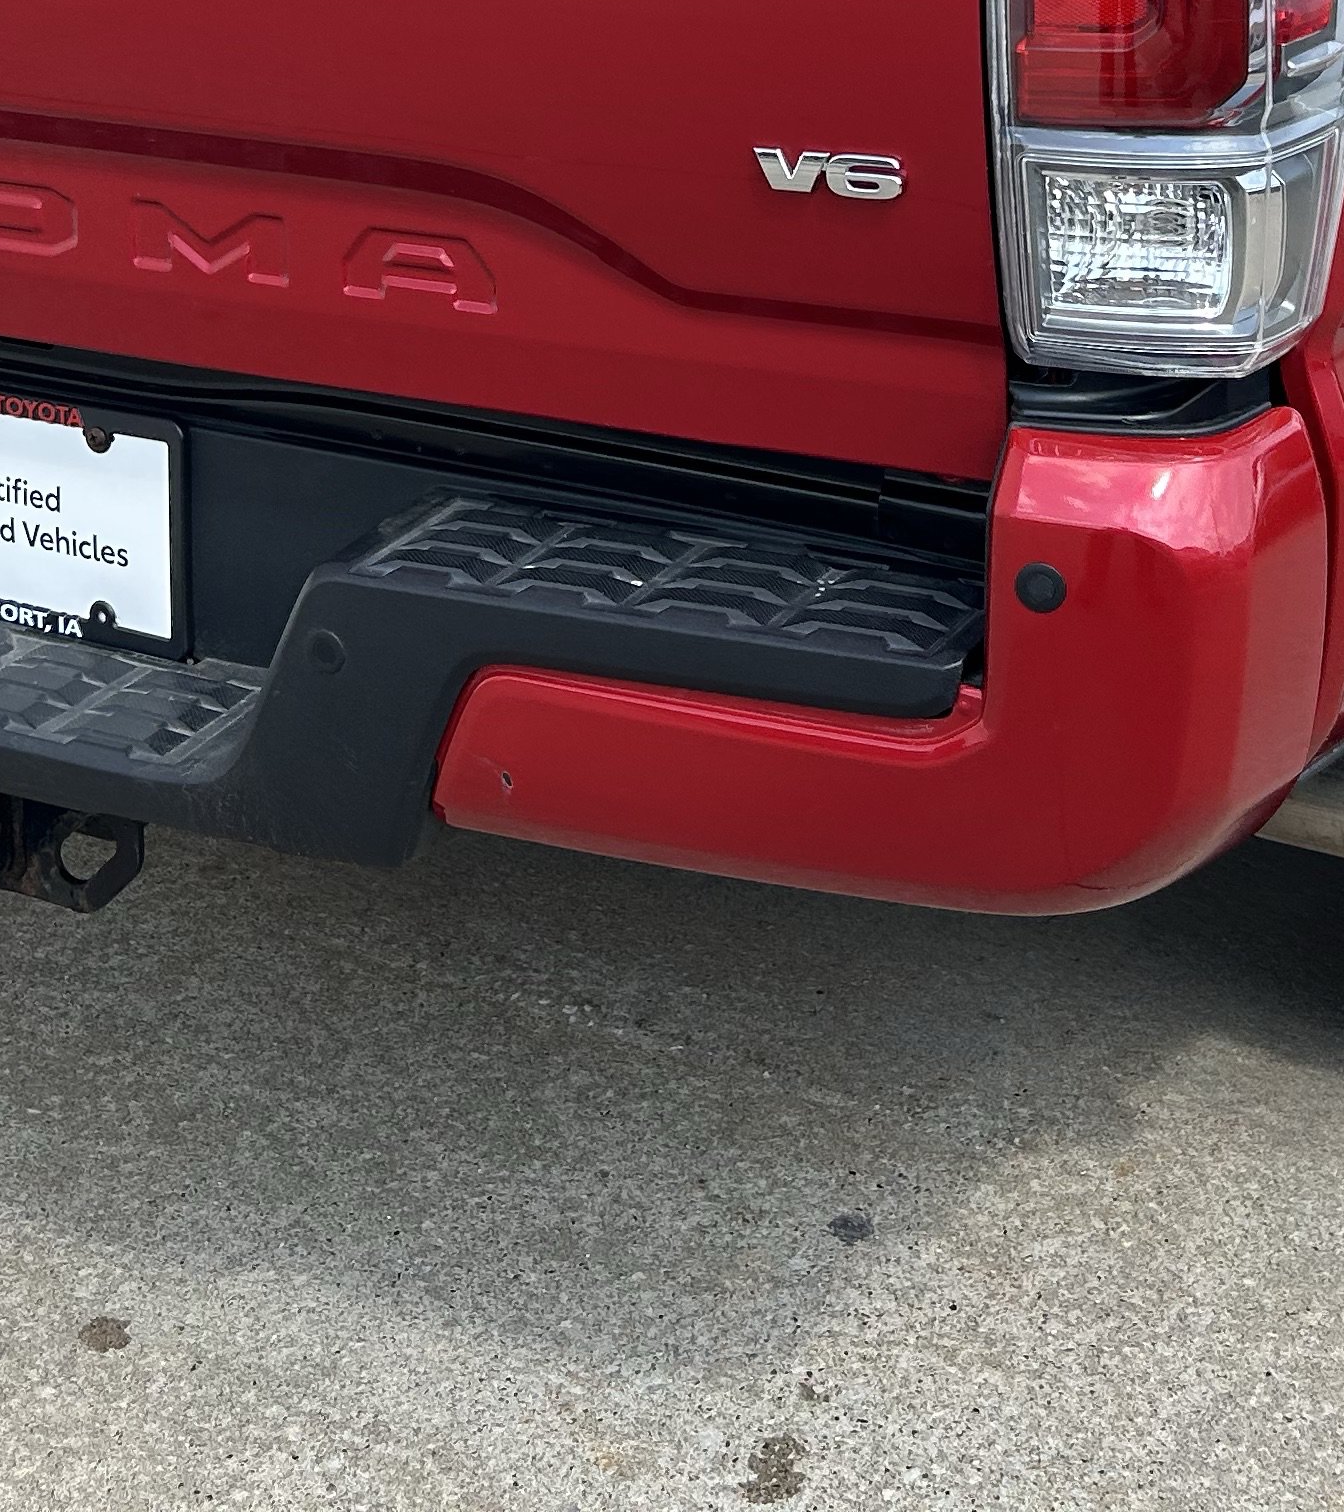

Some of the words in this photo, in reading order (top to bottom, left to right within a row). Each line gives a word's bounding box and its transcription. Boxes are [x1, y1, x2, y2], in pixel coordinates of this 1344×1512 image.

[752, 146, 903, 200] V6
[22, 520, 130, 568] Vehicles
[57, 614, 83, 639] IA
